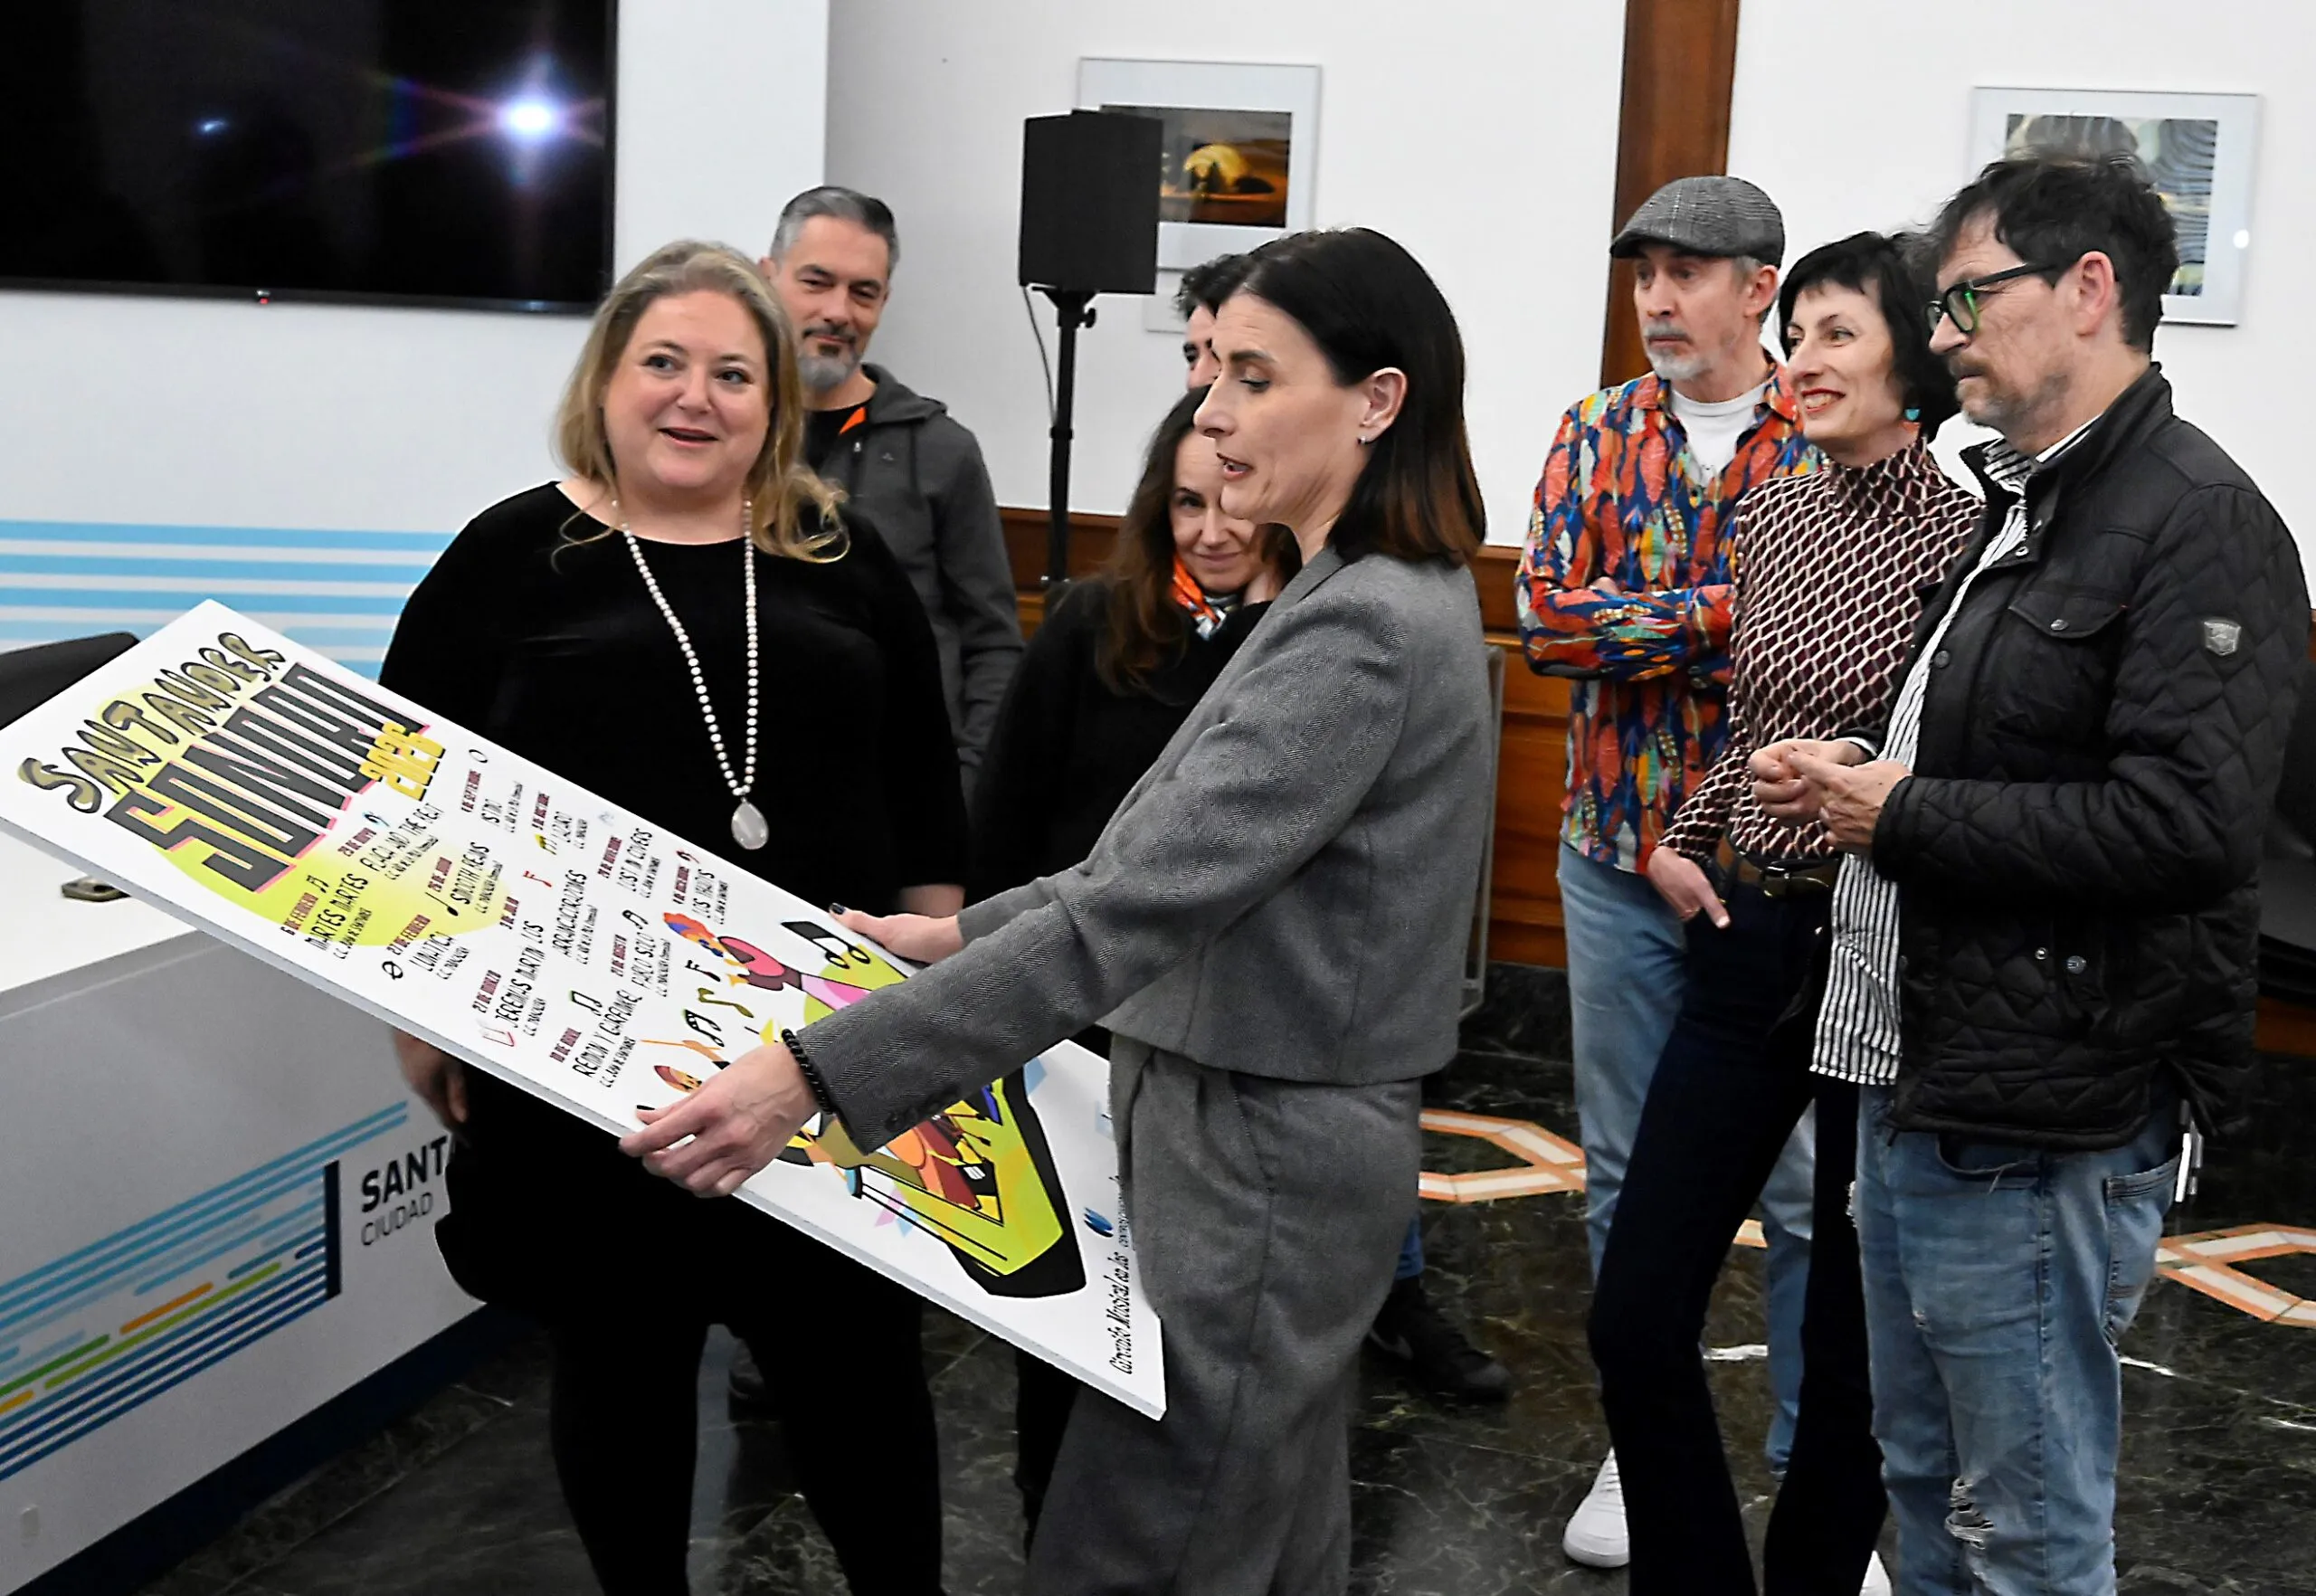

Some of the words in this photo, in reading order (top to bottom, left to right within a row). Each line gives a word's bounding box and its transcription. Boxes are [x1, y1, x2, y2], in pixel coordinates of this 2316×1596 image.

[18, 632, 286, 813] SANTANDER
[357, 721, 447, 800] 2026
[105, 662, 429, 893] SONORO
[412, 802, 444, 824] BEAT
[384, 831, 410, 850] AND
[397, 817, 428, 837] THE
[626, 827, 653, 860] COVERS
[358, 845, 396, 872] FLACA
[449, 867, 481, 906] SMOOTH
[615, 866, 641, 893] LOST
[304, 906, 346, 951] MARTES
[327, 872, 369, 913] MARTES
[691, 898, 711, 919] LOS
[283, 917, 302, 931] DE
[520, 920, 545, 945] LOS
[385, 943, 403, 956] 27
[633, 927, 655, 958] SOLO
[471, 1000, 489, 1014] 27
[598, 989, 643, 1036] GARFUNKEL
[592, 1031, 614, 1045] Y
[361, 1135, 450, 1213] SANT
[361, 1192, 434, 1247] CIUDAD
[1106, 1251, 1130, 1271] los
[1109, 1263, 1131, 1284] en
[1102, 1273, 1132, 1330] Musical
[1106, 1326, 1133, 1375] Circuito
